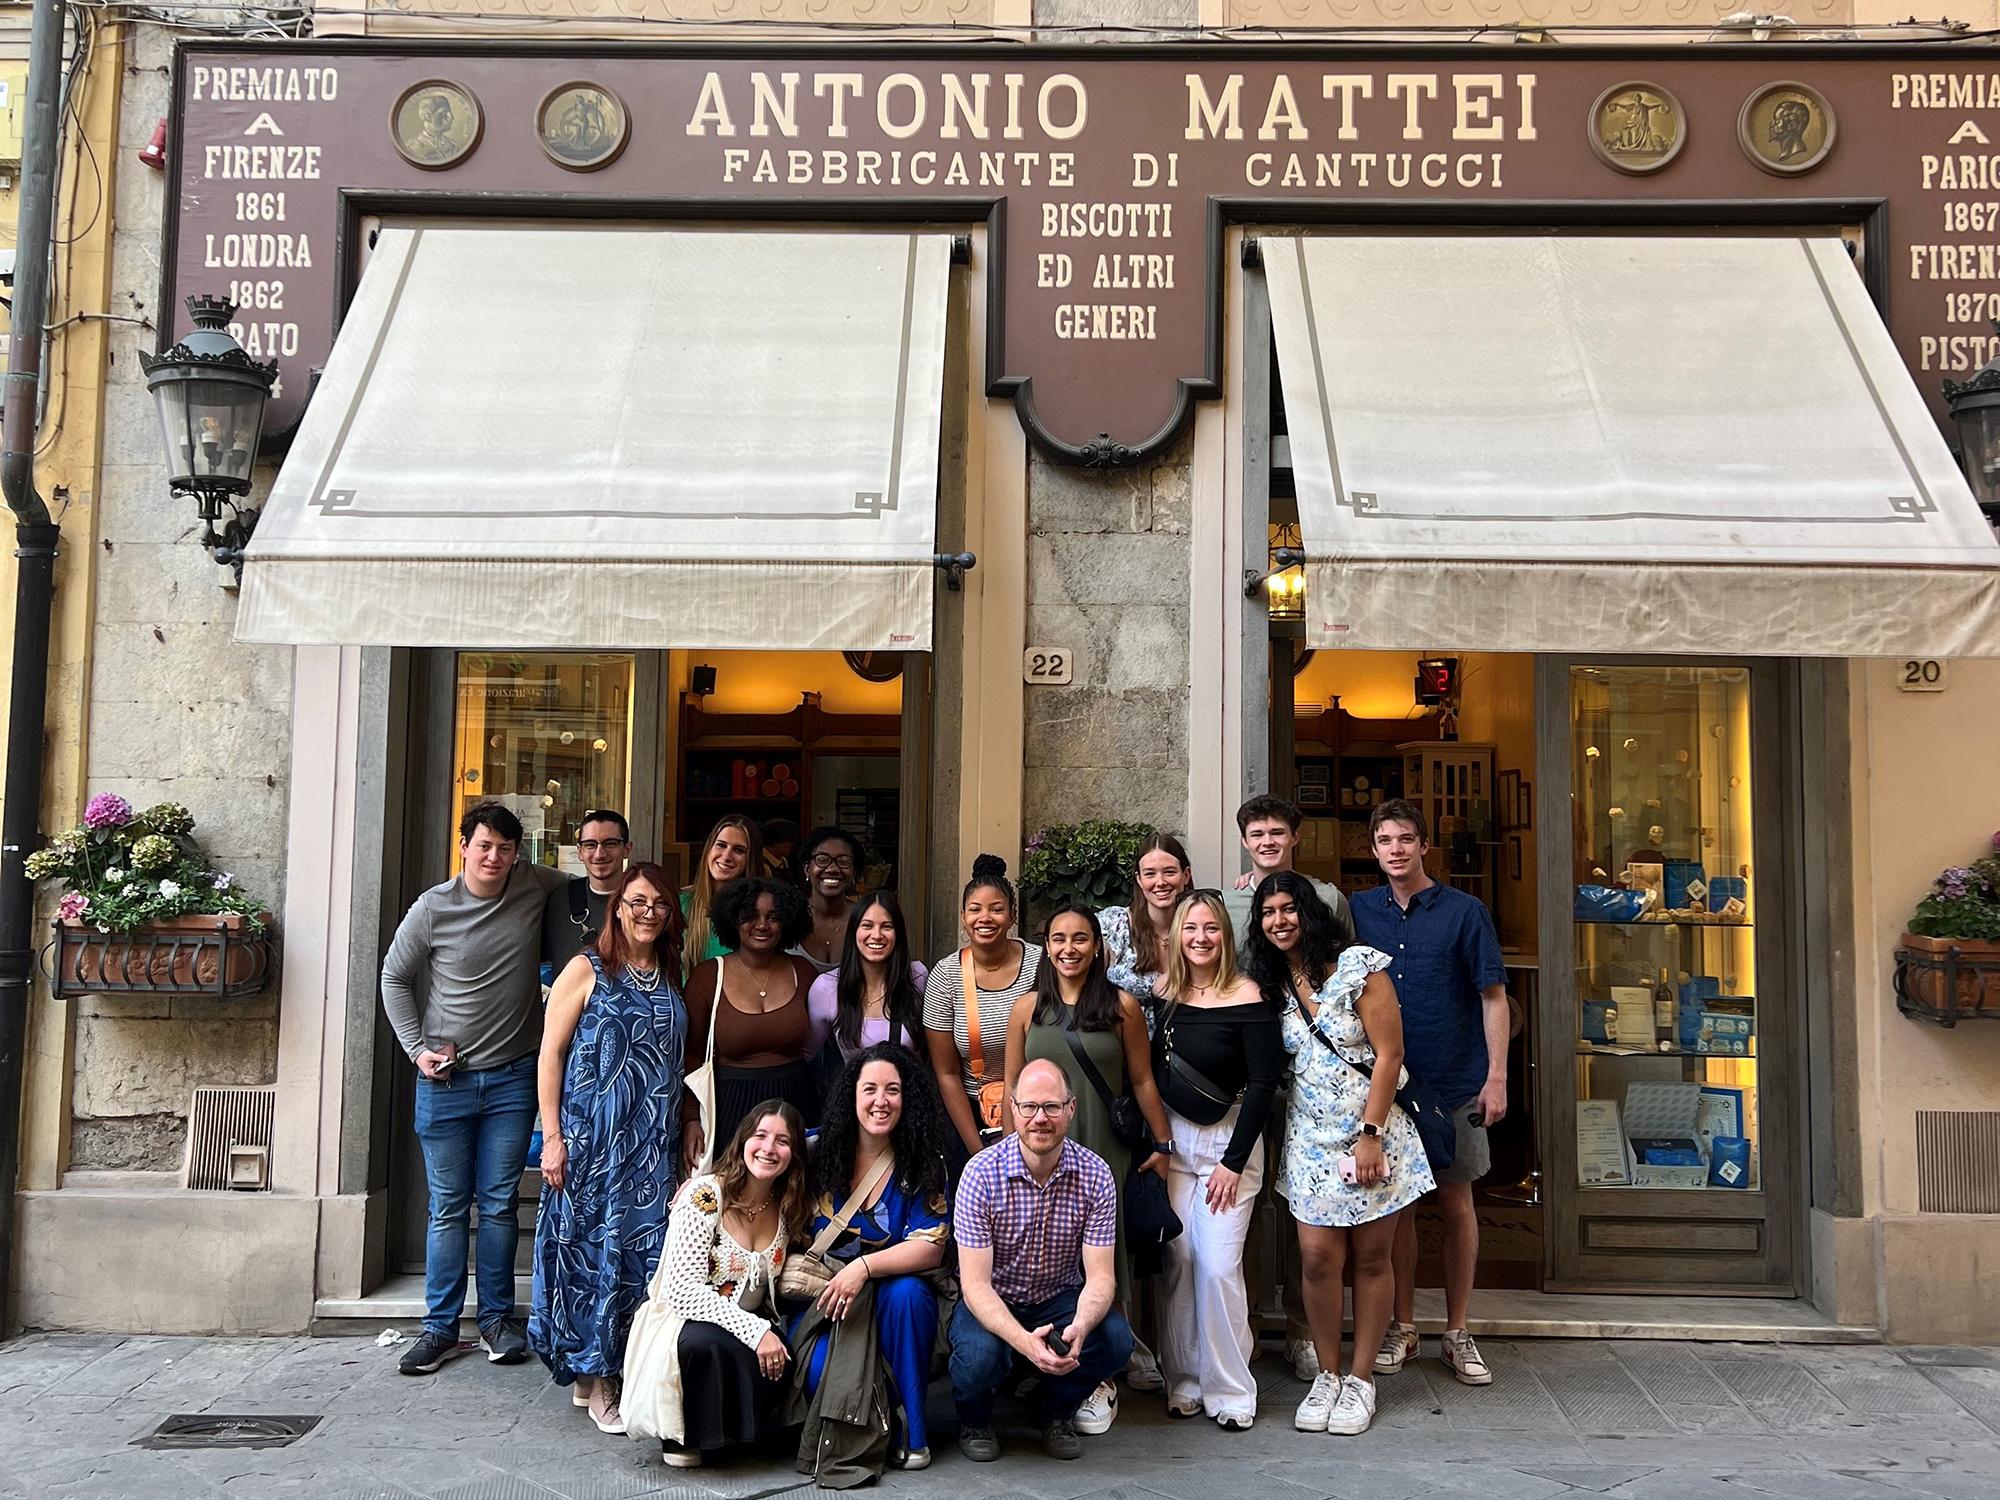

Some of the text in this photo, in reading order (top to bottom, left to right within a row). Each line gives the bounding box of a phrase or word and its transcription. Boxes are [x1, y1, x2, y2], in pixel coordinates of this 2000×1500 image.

[192, 66, 338, 101] PREMIATO
[685, 72, 1537, 141] ANTONIO MATTEI
[244, 112, 283, 136] A
[1948, 120, 1990, 144] A
[204, 145, 321, 180] FIRENZE
[723, 149, 1503, 188] FABBRICANTE DI CANTUCCI
[235, 192, 286, 221] 1861
[1041, 202, 1172, 238] BISCOTTI
[1943, 202, 2000, 232] 1867
[204, 234, 312, 268] LONDRA
[1910, 245, 2000, 280] FIREN
[1037, 253, 1175, 289] ED ALTRI
[229, 280, 284, 310] 1862
[1945, 293, 2000, 323] 1870
[1055, 304, 1157, 340] GENERI
[228, 322, 299, 357] RATO
[1031, 653, 1063, 676] 22
[1437, 669, 1449, 691] 2
[1905, 660, 1940, 683] 20
